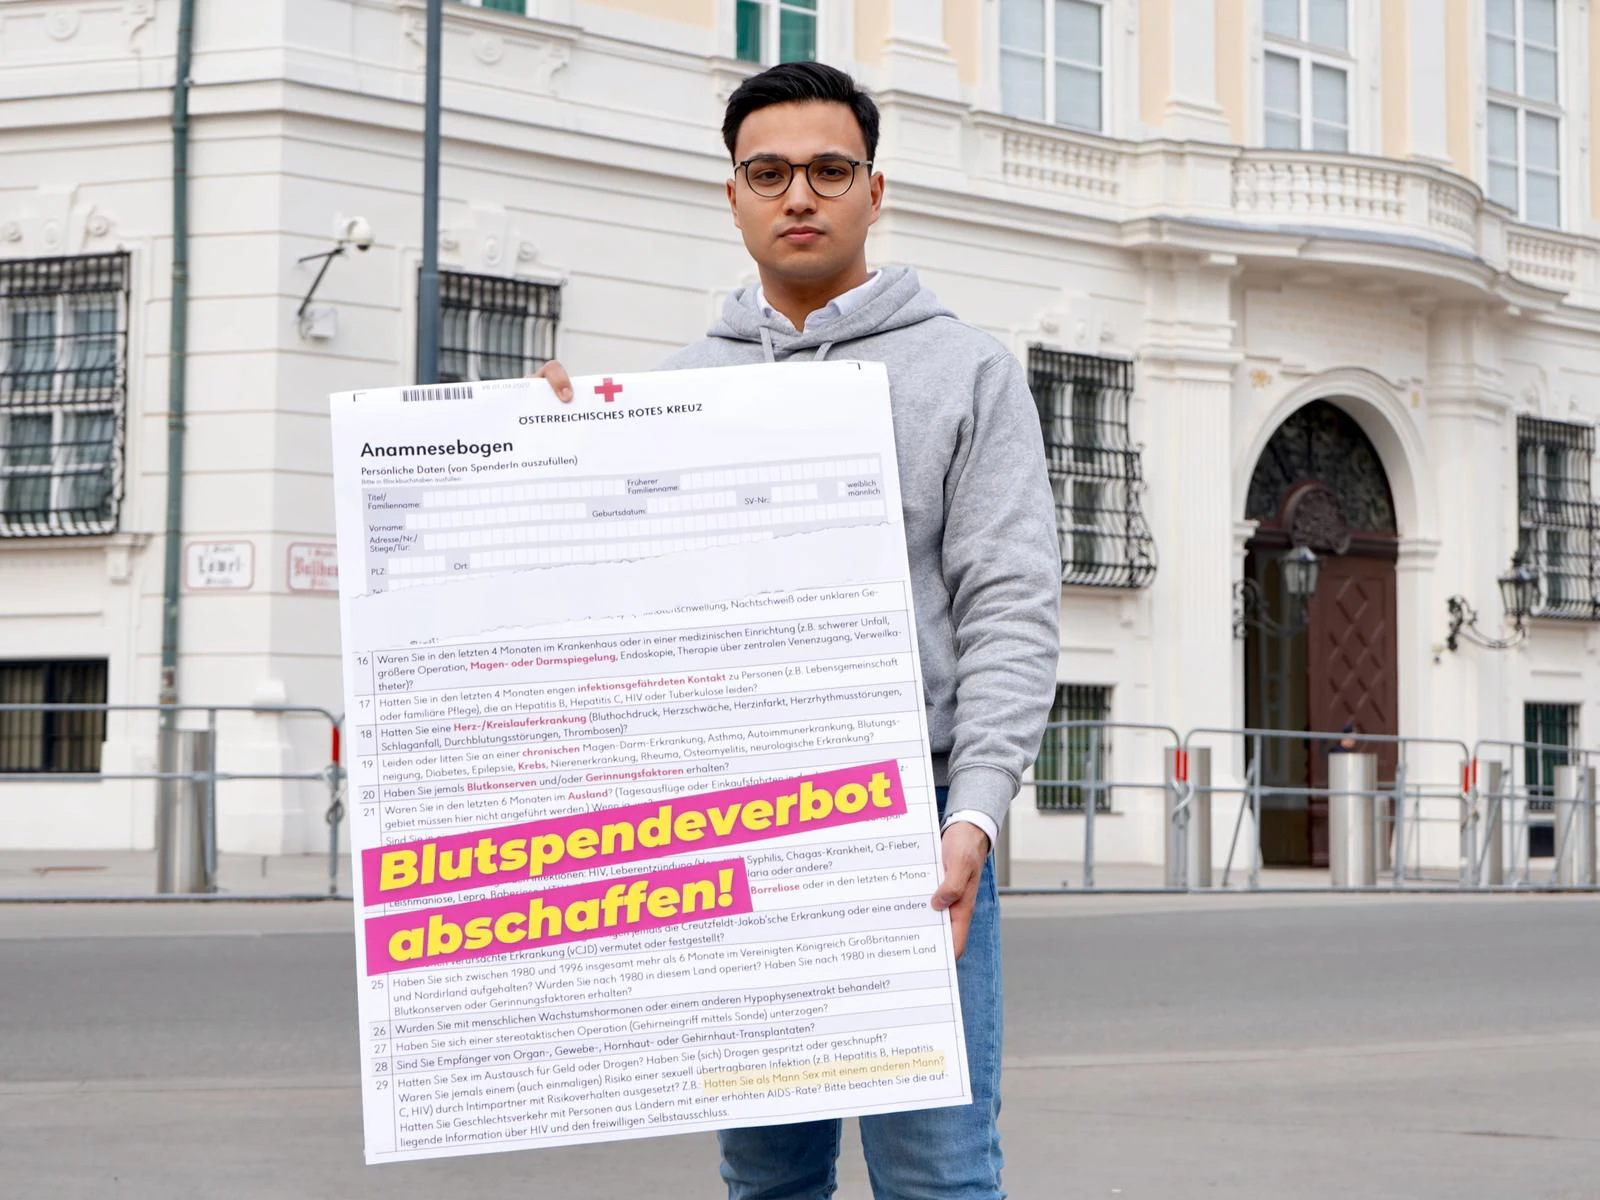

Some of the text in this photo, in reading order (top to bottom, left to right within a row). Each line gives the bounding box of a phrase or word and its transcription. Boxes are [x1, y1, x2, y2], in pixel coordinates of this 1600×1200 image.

[628, 406, 663, 418] ROTES
[666, 403, 703, 414] KREUZ
[360, 438, 514, 458] Anamnesebogen
[361, 455, 578, 476] Persönliche Daten (von SpenderIn auszufüllen)
[730, 589, 877, 608] Nachtschweiß oder unklaren Ge-
[357, 656, 369, 666] 16
[377, 655, 409, 664] Waren
[411, 653, 425, 662] Sie
[438, 650, 456, 660] den
[458, 649, 490, 658] letzten
[491, 647, 498, 655] 4
[500, 645, 542, 655] Monaten
[557, 639, 618, 651] Krankenhaus
[619, 637, 641, 647] oder
[653, 636, 677, 644] einer
[678, 630, 743, 642] medizinischen
[744, 626, 796, 637] Einrichtung
[818, 621, 858, 630] schwerer
[860, 616, 890, 627] Unfall,
[377, 667, 415, 680] größere
[417, 664, 468, 676] Operation,
[470, 662, 509, 671] Magen-
[510, 657, 534, 668] oder
[620, 649, 676, 660] Endoskopie,
[677, 646, 718, 656] Therapie
[720, 642, 742, 652] über
[743, 639, 787, 650] zentralen
[787, 635, 853, 646] Venenzugang,
[854, 629, 901, 640] Verweilka-
[378, 679, 414, 691] theter)?
[360, 729, 372, 739] 18
[381, 729, 413, 737] Hatten
[415, 726, 430, 735] Sie
[431, 725, 452, 734] eine
[453, 714, 587, 732] Herz-/Kreislauferkrankung
[734, 697, 788, 710] Herzinfarkt,
[381, 738, 442, 754] Schlaganfall,
[563, 723, 628, 737] Thrombosen)?
[362, 762, 730, 800] 20 Haben Sie jemals Blutkonserven und/oder Gerinnungsfaktoren erhalten?
[380, 774, 890, 890] Blutspendeverbot
[747, 853, 784, 866] Syphilis,
[875, 840, 920, 852] Q-Fieber,
[751, 883, 800, 895] Borreliose
[802, 880, 824, 890] oder
[836, 877, 855, 886] den
[857, 875, 889, 884] letzten
[891, 872, 897, 881] 6
[899, 871, 929, 879] Mona-
[388, 871, 732, 964] abschaffen!
[373, 979, 890, 1037] 26 Wurden Sie mit menschlichen Wachstumshormonen oder einem anderen Hypophysenextrakt behandelt?
[394, 986, 632, 1016] Blutkonserven oder Gerinnungsfaktoren erhalten?
[375, 1023, 815, 1072] 28 Sind Sie Empfänger von Organ-, Gewebe-, Hornhaut- oder Gehirnhaut-Transplantaten?
[399, 1108, 409, 1118] C,
[411, 1104, 434, 1117] HIV)
[435, 1103, 464, 1114] durch
[466, 1099, 527, 1111] Intimpartner
[529, 1096, 545, 1105] mit
[547, 1089, 621, 1103] Risikoverhalten
[622, 1082, 680, 1098] ausgesetzt?
[704, 1079, 737, 1088] Hatten
[740, 1076, 754, 1086] Sie
[756, 1075, 770, 1084] als
[772, 1073, 800, 1082] Mann
[802, 1071, 819, 1080] Sex
[822, 1069, 836, 1077] mit
[839, 1067, 868, 1075] einem
[870, 1062, 910, 1072] anderen
[912, 1056, 944, 1067] Mann?
[400, 1070, 947, 1132] Hatten Sie Geschlechtsverkehr mit Personen aus Ländern mit einer erhöhten AIDS-Rate? Bitte beachten Sie die auf-
